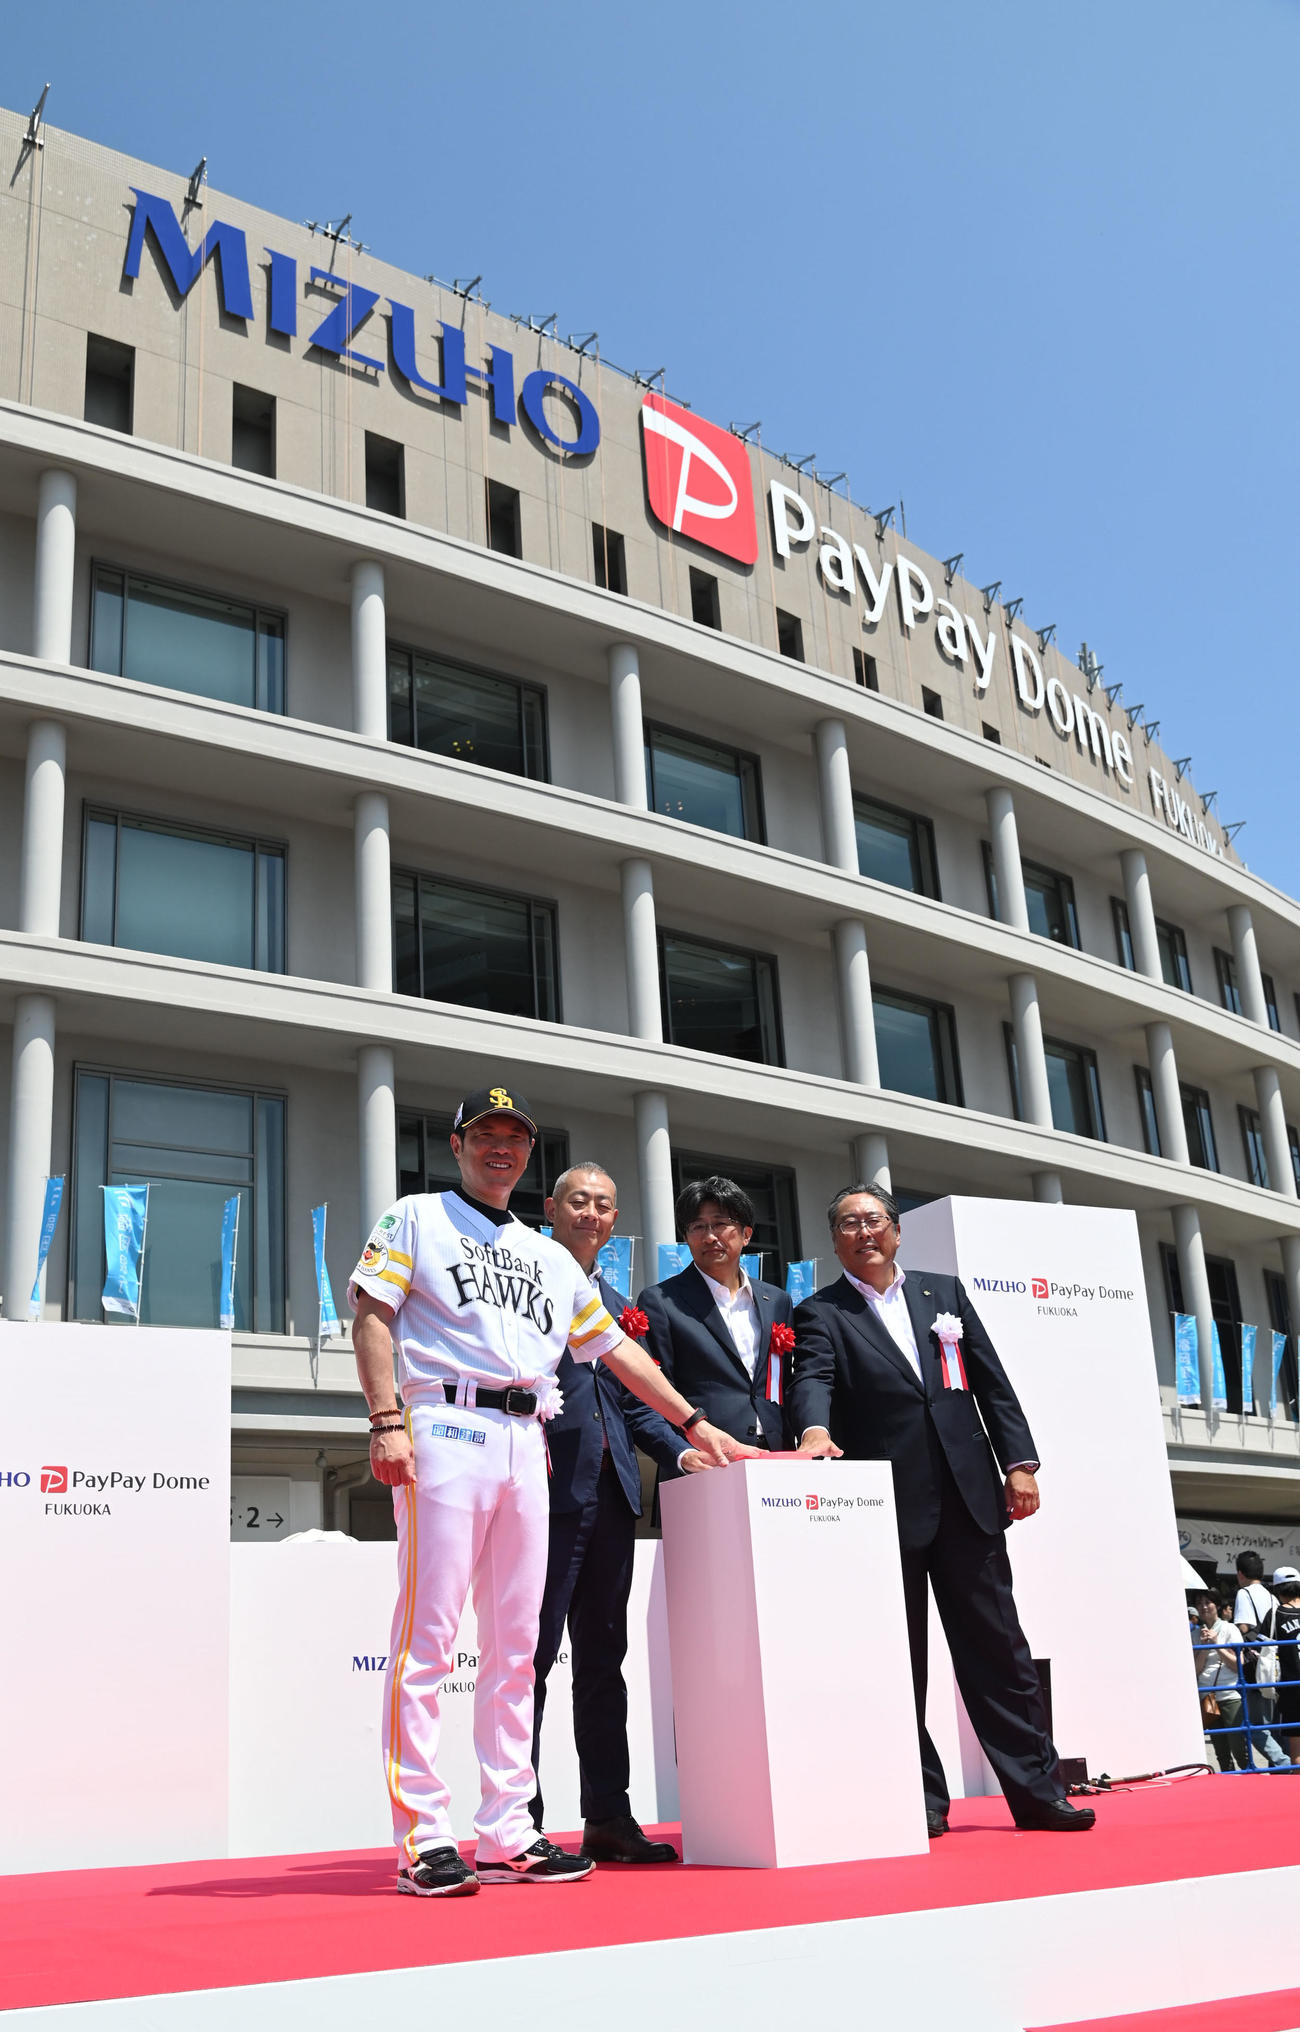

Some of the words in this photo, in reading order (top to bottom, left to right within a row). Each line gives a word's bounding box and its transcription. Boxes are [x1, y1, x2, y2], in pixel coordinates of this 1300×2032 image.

[125, 186, 600, 455] MIZUHO
[770, 479, 996, 689] PayPay
[1012, 632, 1134, 784] Dome
[460, 1237, 543, 1287] SoftBank
[446, 1262, 554, 1336] HAWKS
[973, 1277, 1026, 1294] MIZUHO
[1050, 1282, 1095, 1301] PayPay
[1098, 1285, 1134, 1300] Dome
[1037, 1306, 1078, 1317] FUKUOKA
[72, 1471, 146, 1492] PayPay
[153, 1472, 210, 1490] Dome
[45, 1504, 111, 1516] FUKUOKA
[761, 1497, 802, 1508] MIZUHO
[820, 1497, 855, 1509] PayPay
[857, 1497, 884, 1507] Dome
[352, 1655, 390, 1672] MIZ
